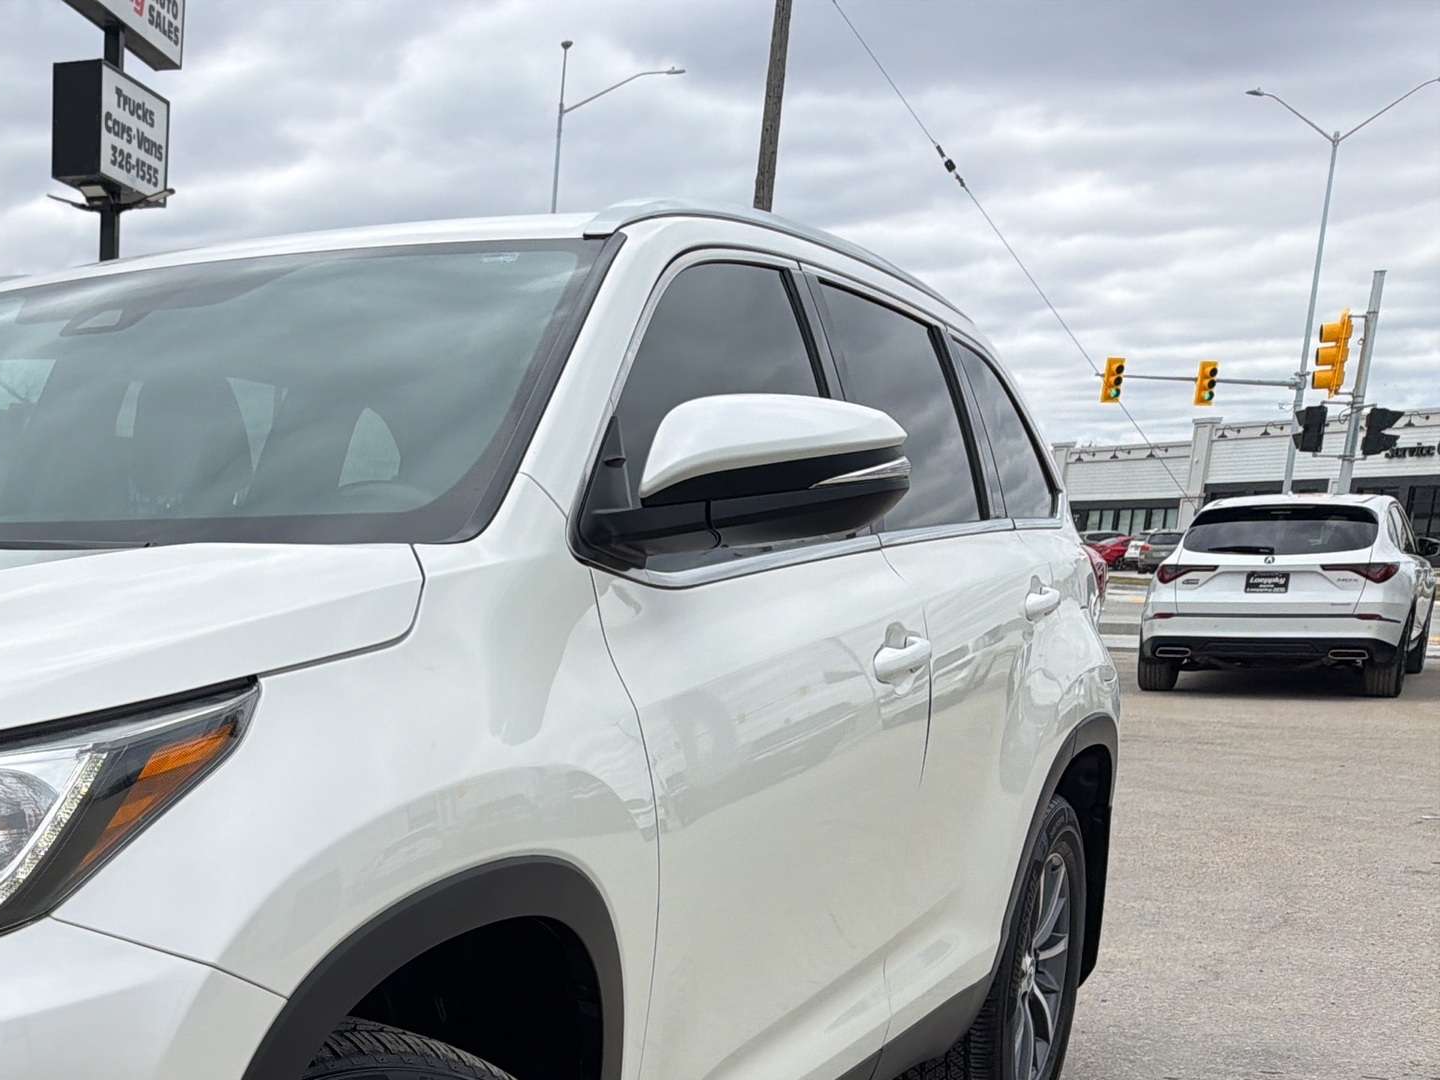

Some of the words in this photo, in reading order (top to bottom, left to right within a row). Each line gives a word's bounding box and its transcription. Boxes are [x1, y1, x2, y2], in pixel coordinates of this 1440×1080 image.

[148, 4, 180, 46] SALES
[115, 85, 155, 129] Trucks
[111, 144, 159, 188] 326-1555
